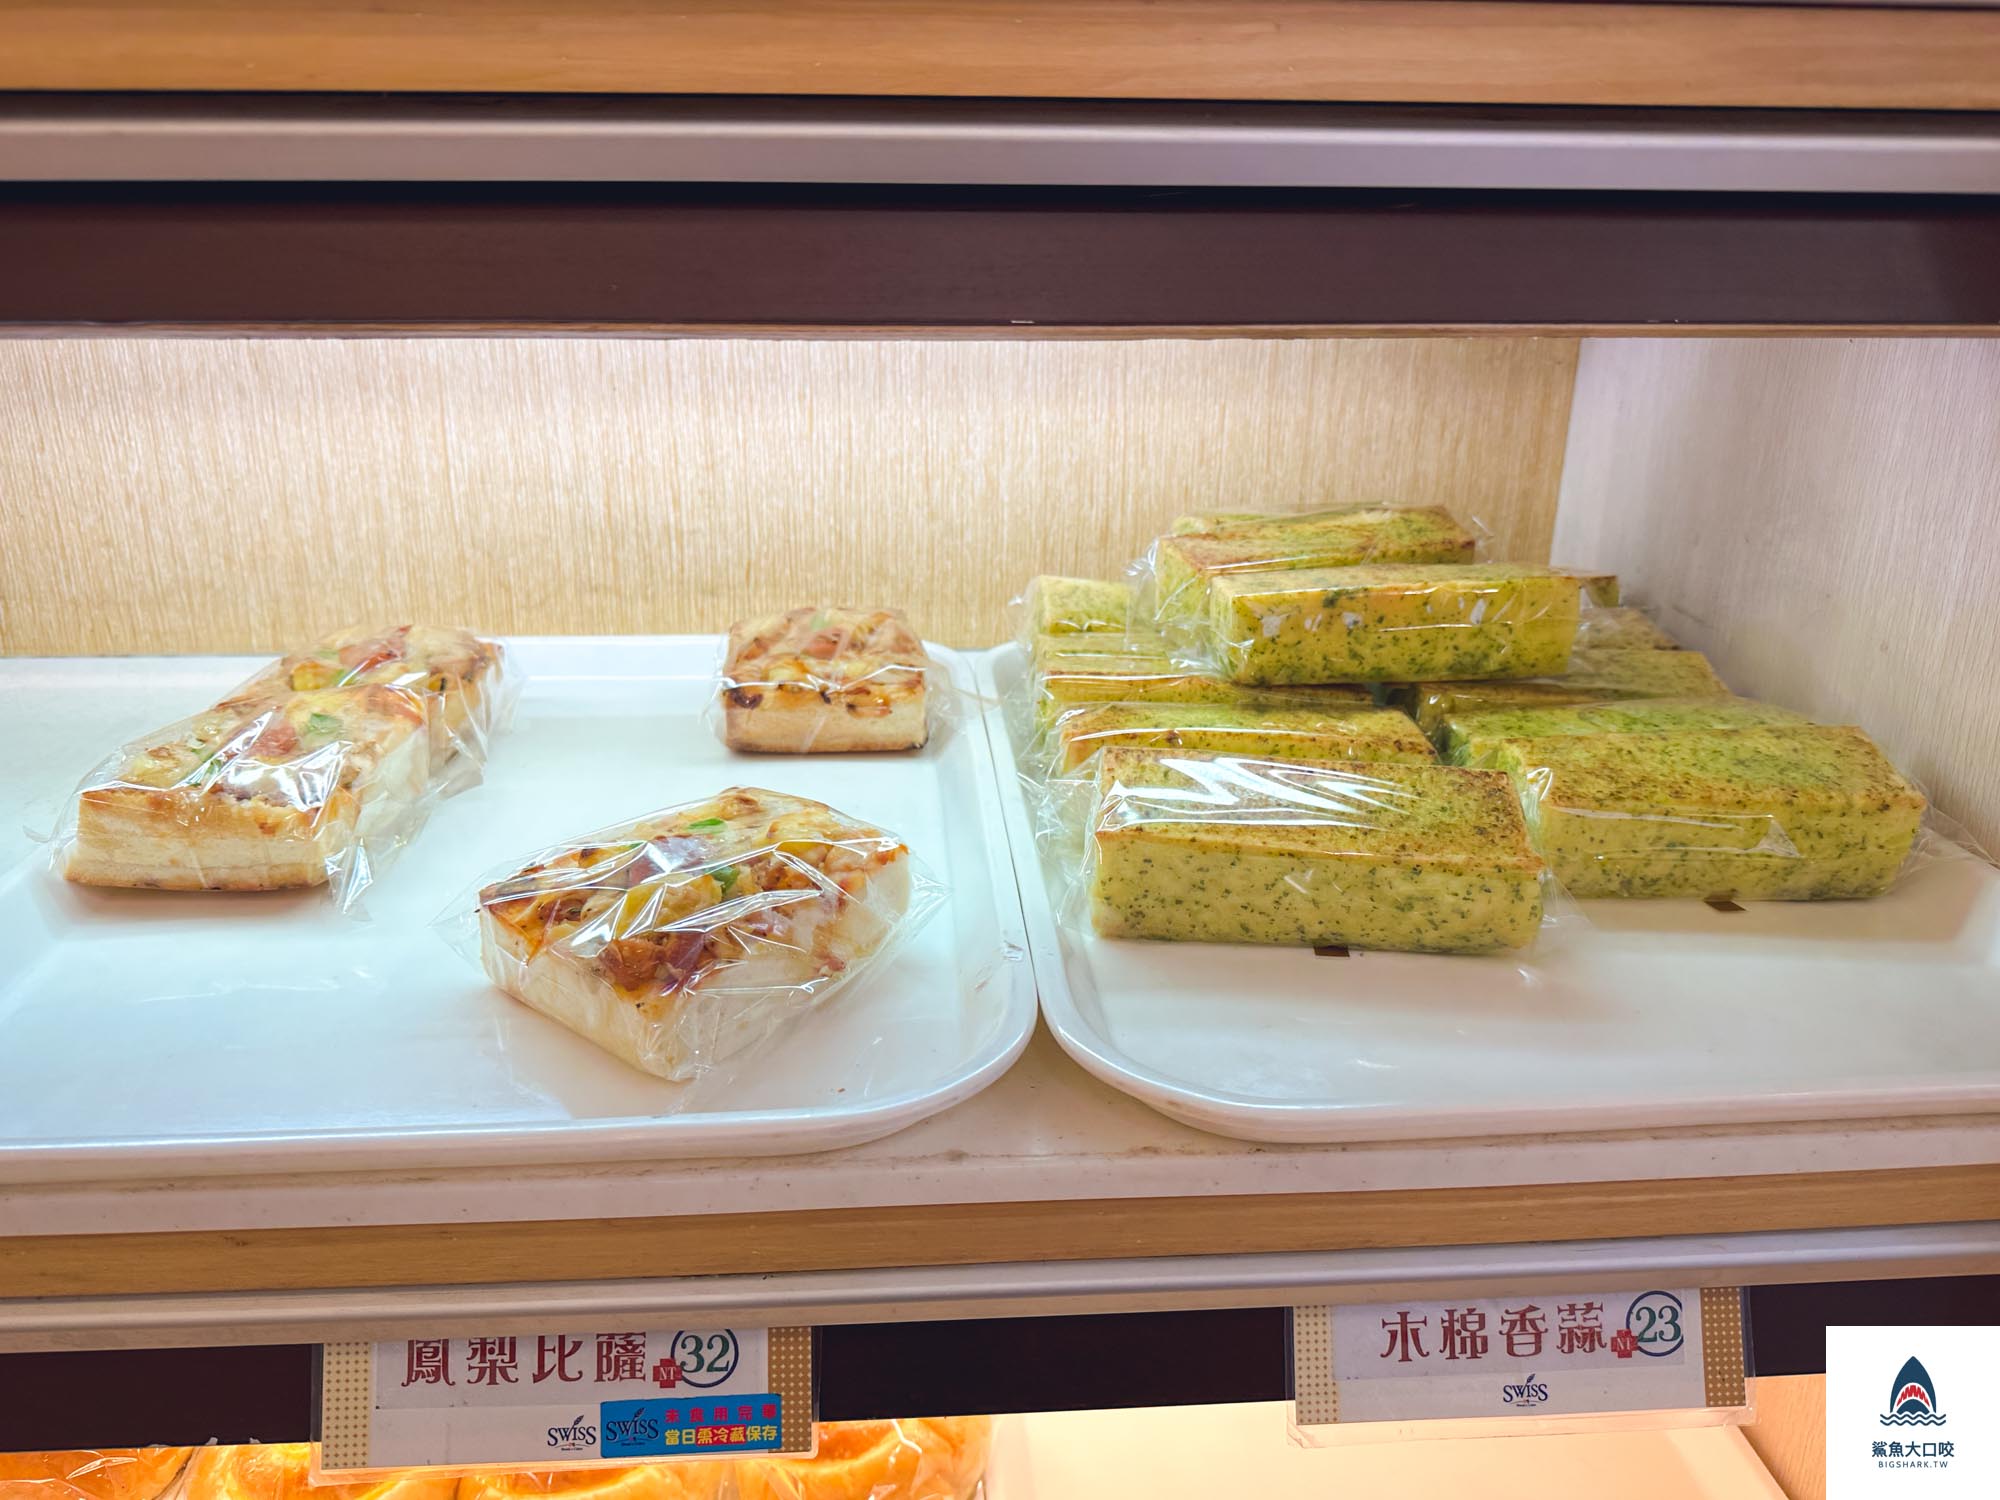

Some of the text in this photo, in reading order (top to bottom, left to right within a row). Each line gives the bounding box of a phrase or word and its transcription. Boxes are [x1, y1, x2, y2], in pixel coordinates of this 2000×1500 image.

[1379, 1302, 1608, 1362] 木棉香蒜
[1635, 1305, 1682, 1343] 23
[401, 1332, 730, 1387] 鳳梨比薩 NT 32
[1502, 1380, 1549, 1403] SWISS
[547, 1422, 597, 1446] SWISS
[605, 1416, 659, 1442] SWISS
